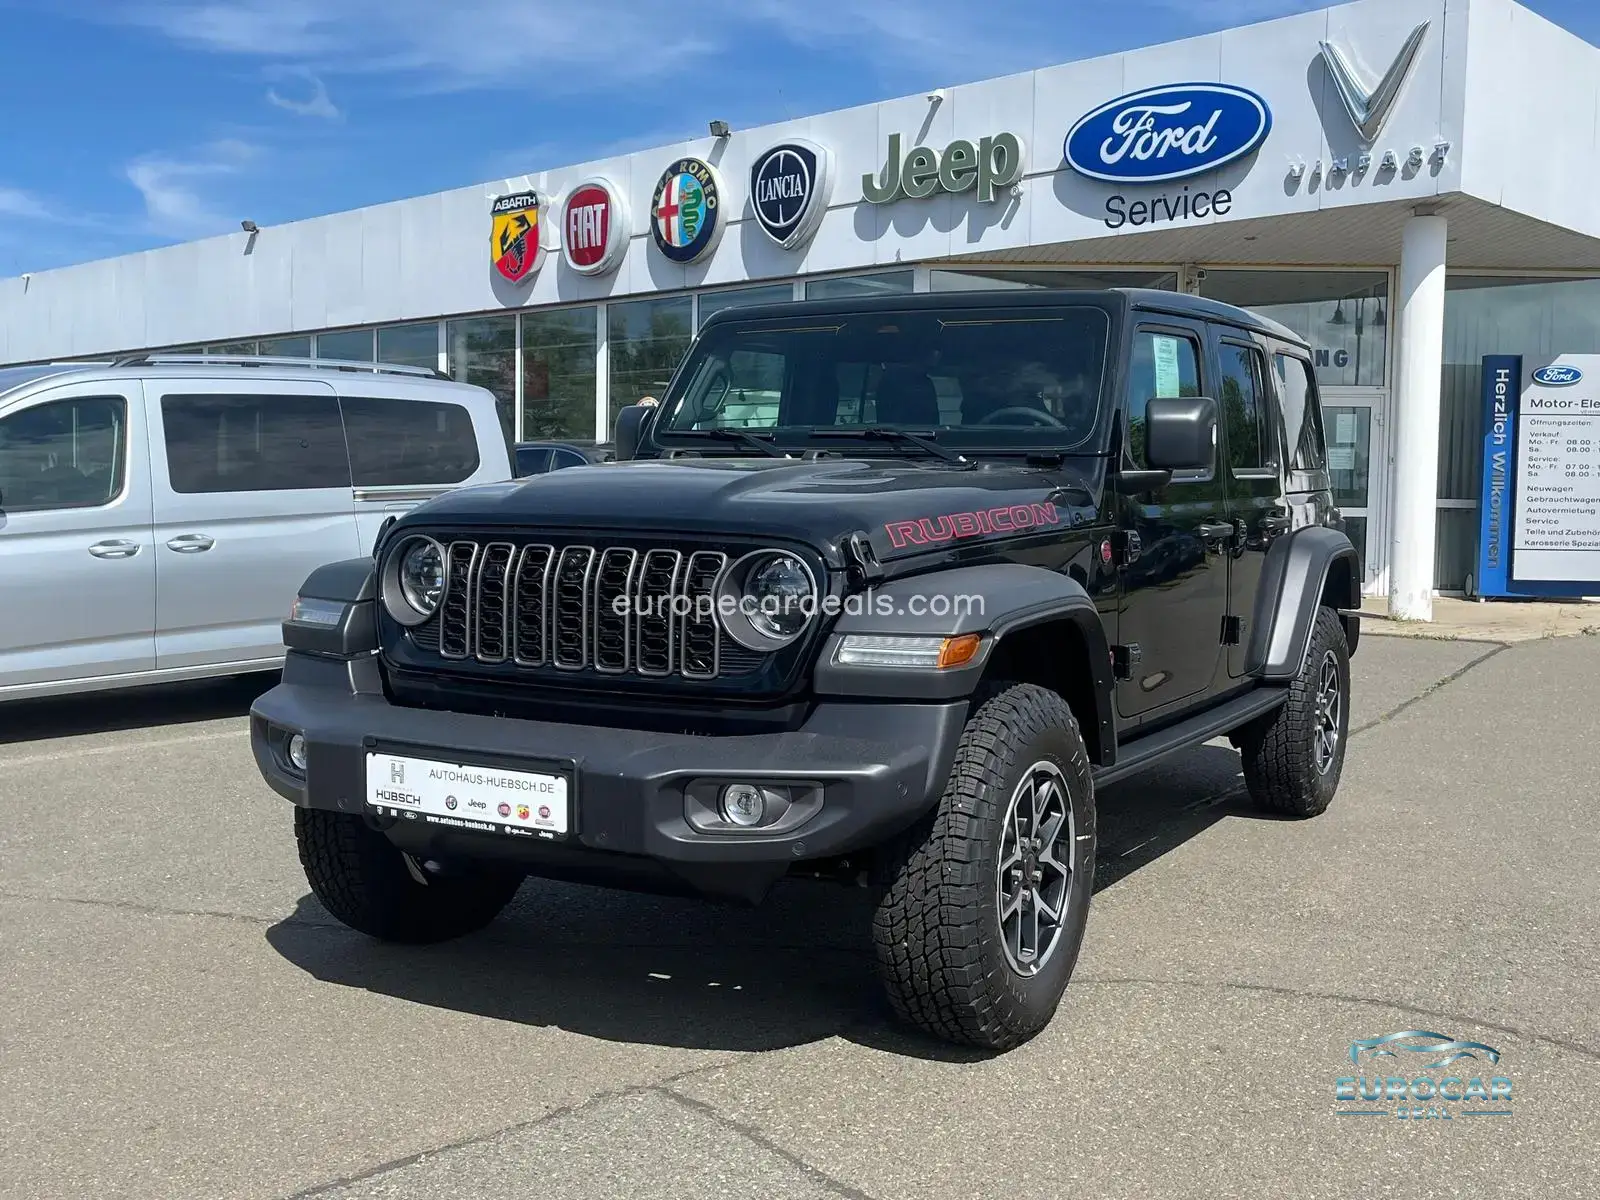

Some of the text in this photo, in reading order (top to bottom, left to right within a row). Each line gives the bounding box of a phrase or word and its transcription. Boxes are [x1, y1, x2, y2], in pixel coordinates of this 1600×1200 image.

[1099, 100, 1223, 164] Ford
[679, 161, 717, 209] ROMEO
[759, 173, 804, 203] LANCIA
[861, 131, 1023, 204] Jeep
[494, 195, 537, 212] ABARTH
[1104, 185, 1232, 229] Service
[569, 203, 606, 250] FIAT
[1543, 368, 1574, 381] Ford
[1487, 369, 1510, 569] Herzlich Willkommen
[885, 502, 1060, 548] RUBICON
[1526, 507, 1596, 515] Autovermietung
[429, 769, 555, 794] AUTOHAUS-HUEBSCH.DE
[468, 798, 487, 809] Jeep
